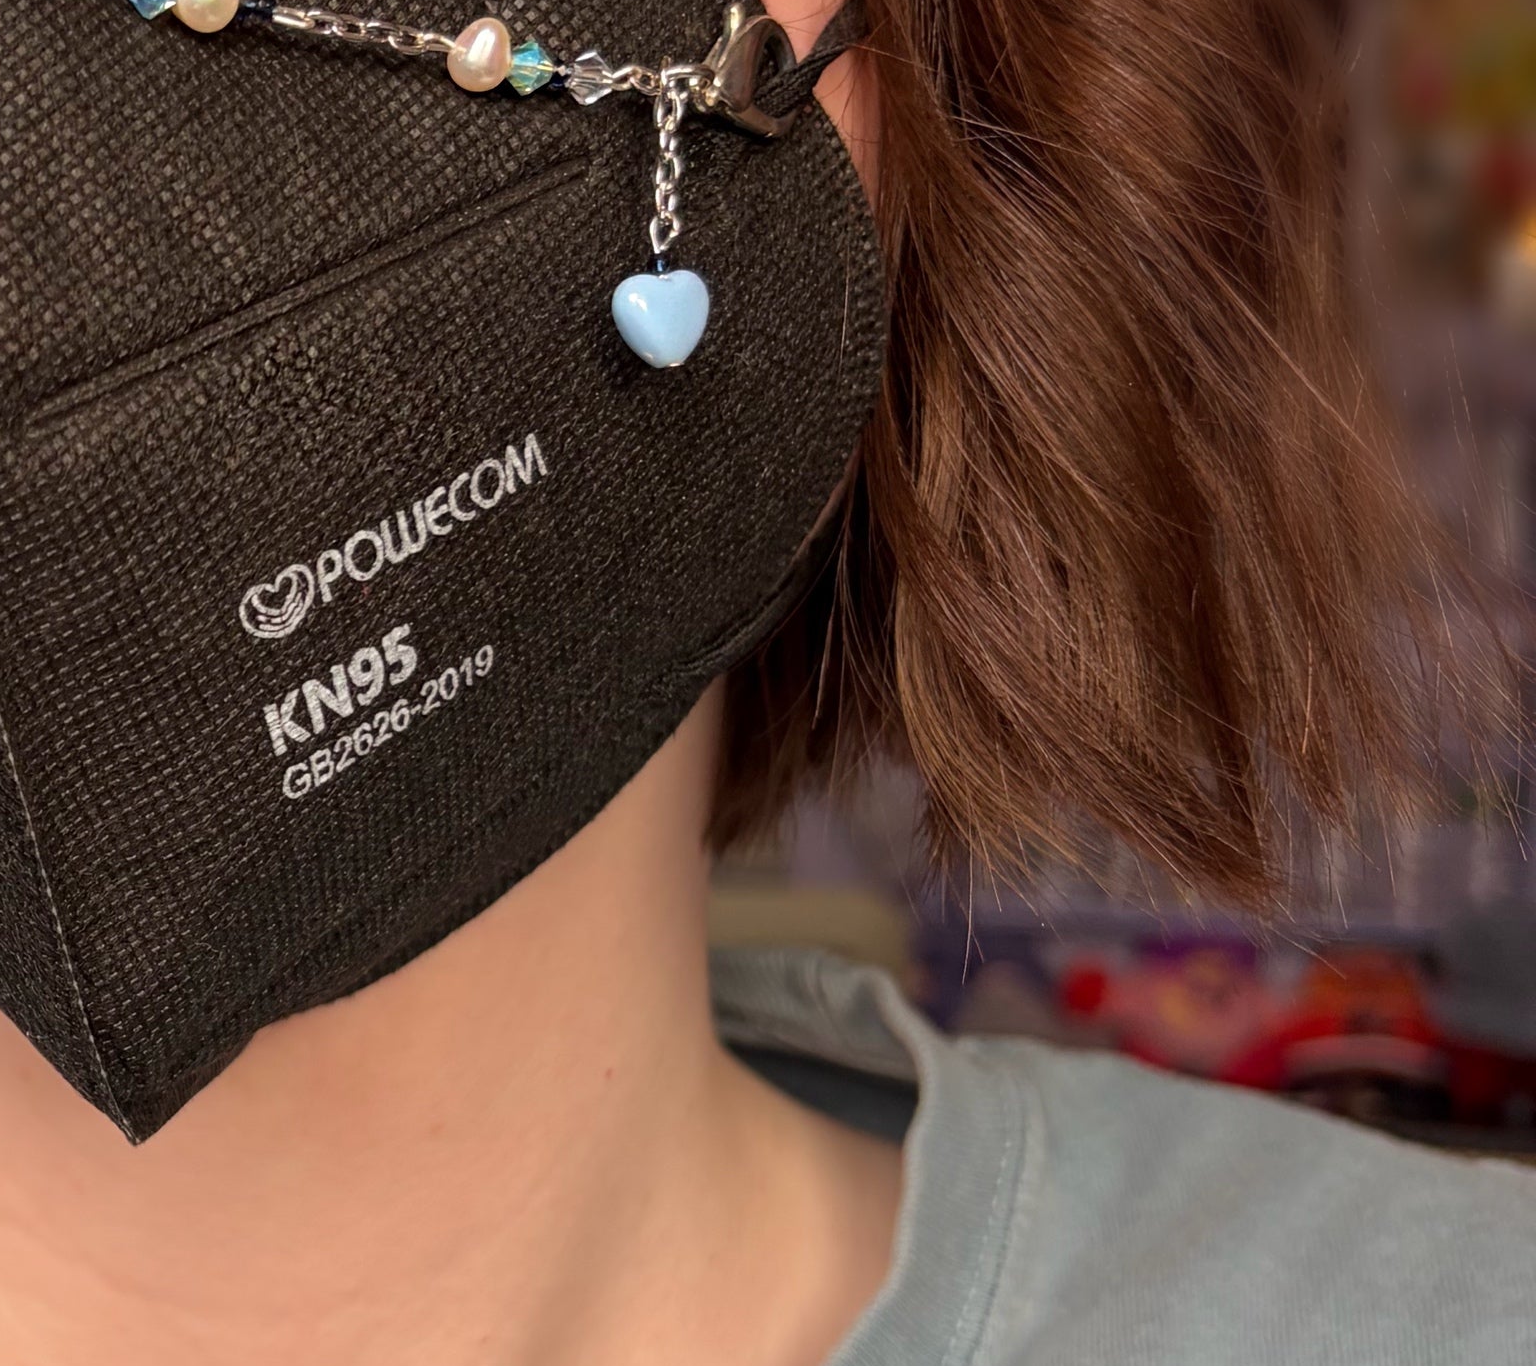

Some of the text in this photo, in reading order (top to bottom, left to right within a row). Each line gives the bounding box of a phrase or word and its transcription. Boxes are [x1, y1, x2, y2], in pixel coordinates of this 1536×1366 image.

[316, 433, 548, 602] POWECOM
[263, 623, 418, 756] KN95
[282, 644, 494, 799] GB2626-2019
